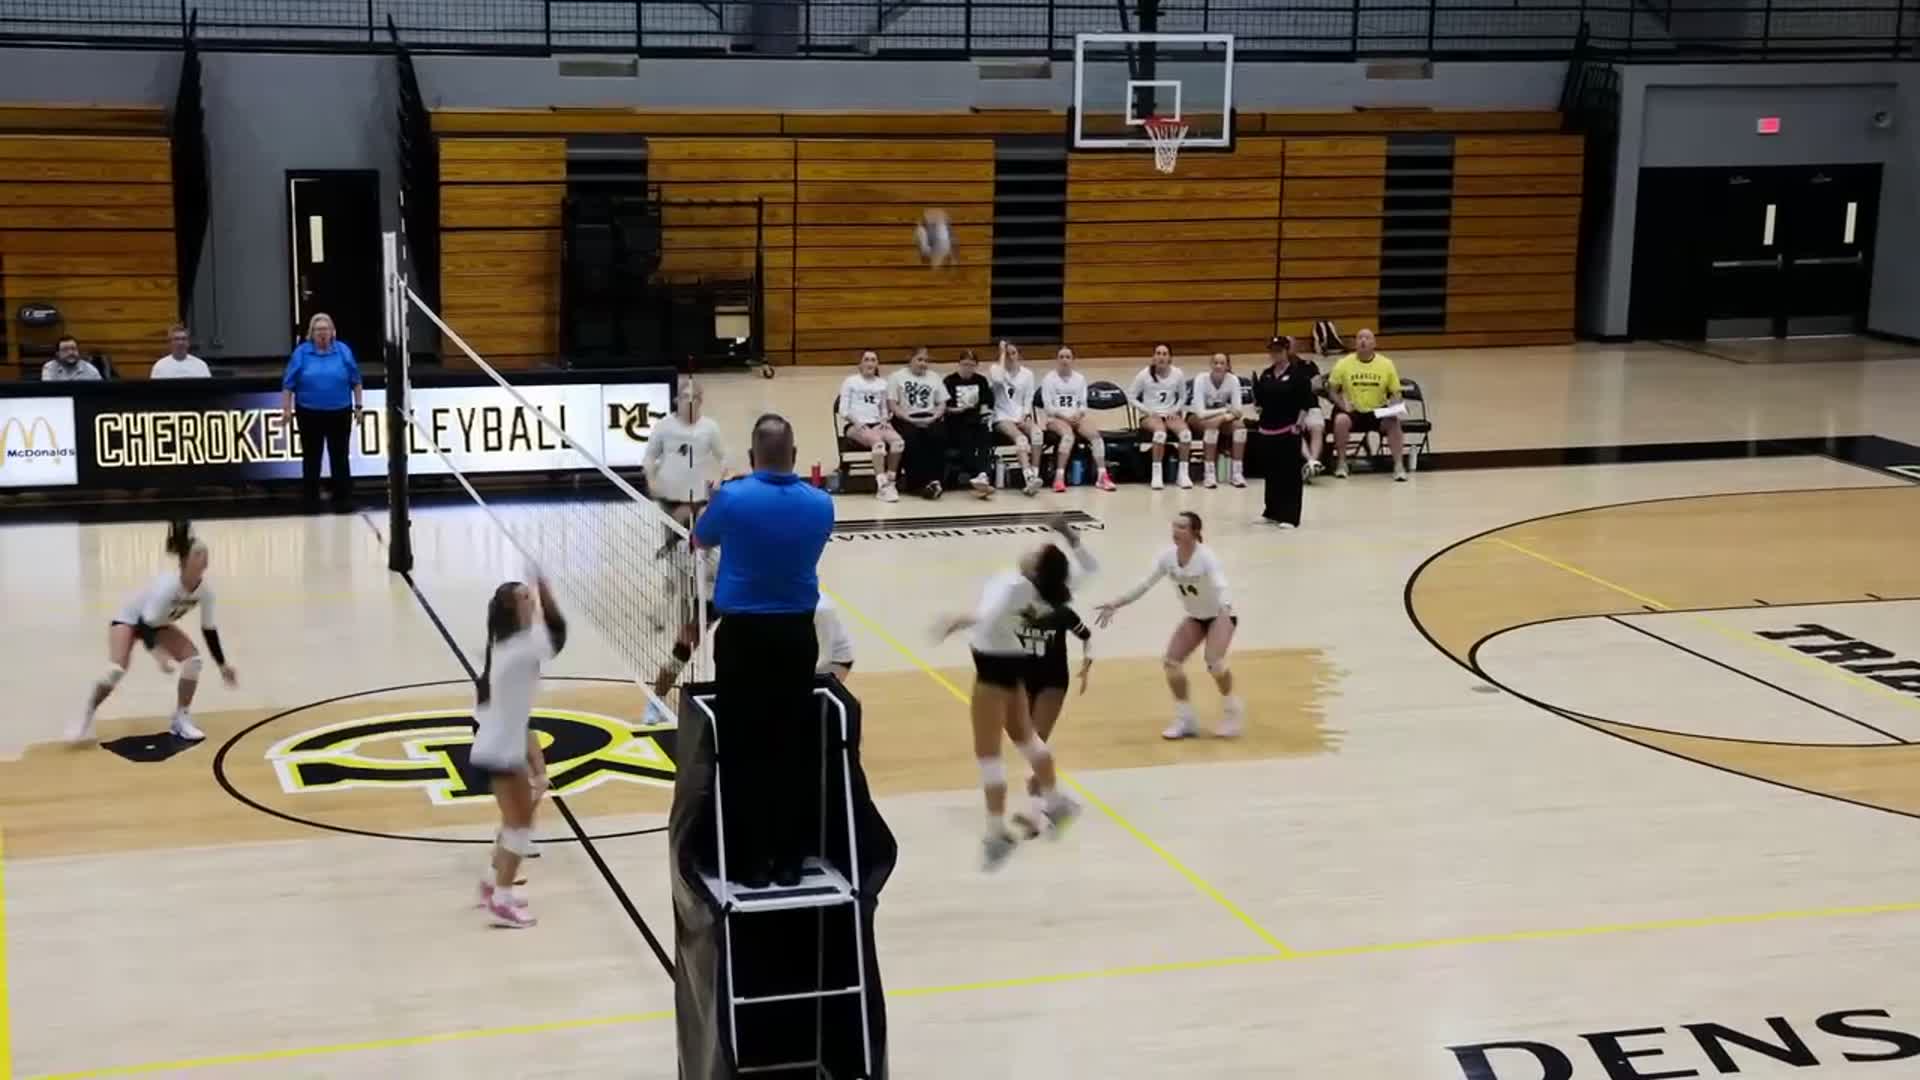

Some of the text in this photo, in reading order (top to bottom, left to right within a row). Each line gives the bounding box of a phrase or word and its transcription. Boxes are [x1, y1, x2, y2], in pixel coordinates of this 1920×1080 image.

[1059, 395, 1073, 407] 22
[7, 447, 76, 458] McDonalds
[1177, 583, 1199, 597] 14
